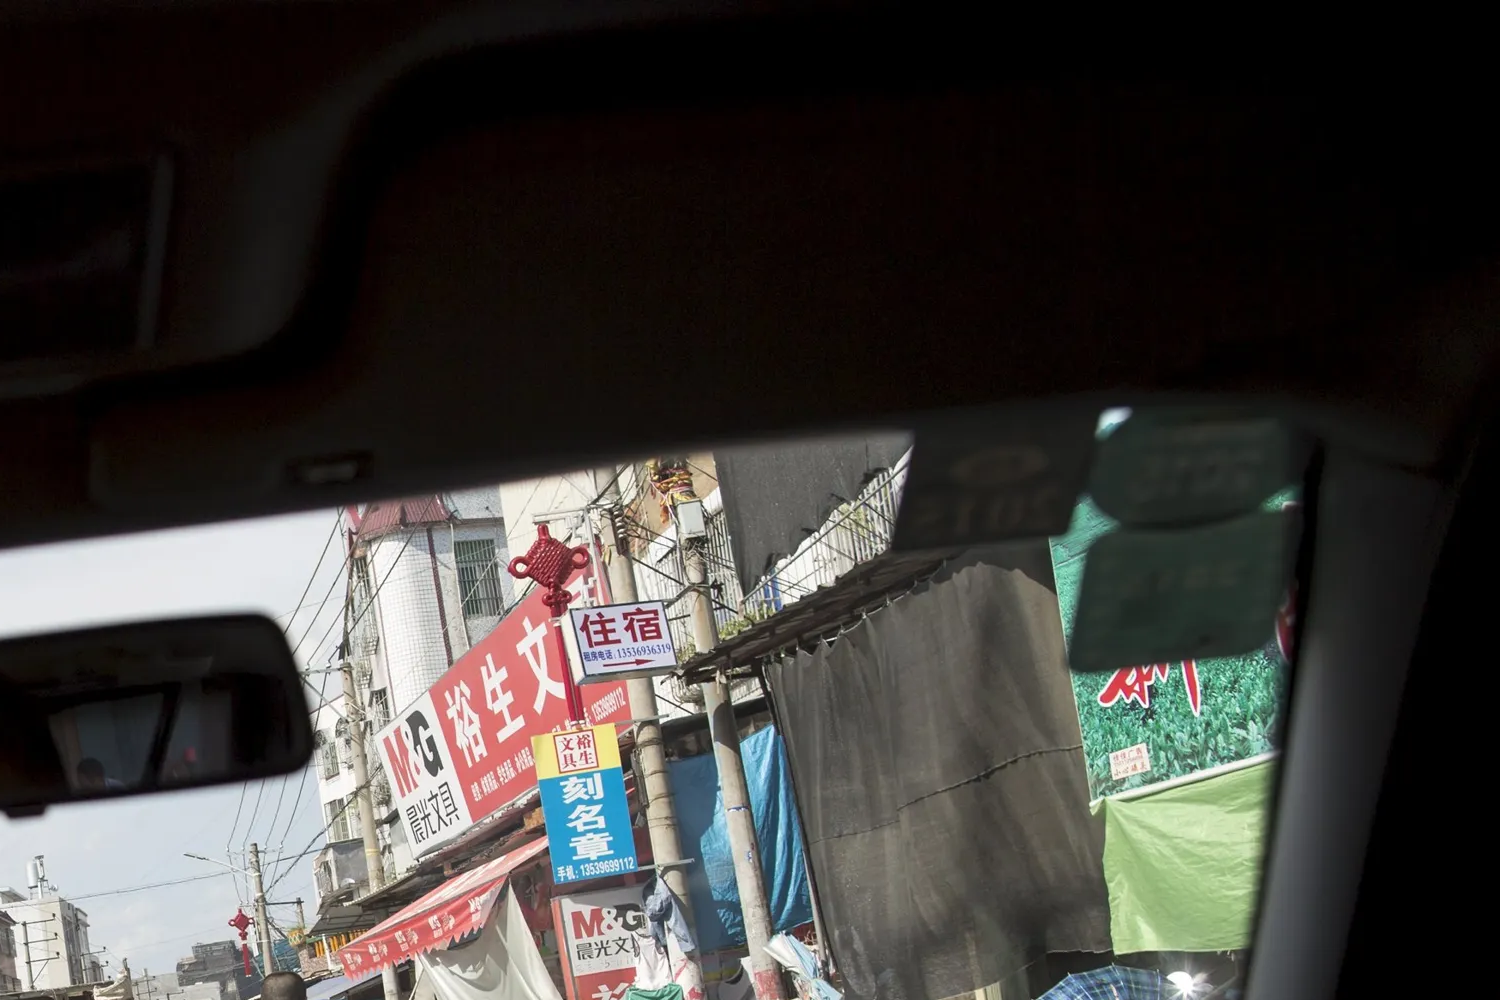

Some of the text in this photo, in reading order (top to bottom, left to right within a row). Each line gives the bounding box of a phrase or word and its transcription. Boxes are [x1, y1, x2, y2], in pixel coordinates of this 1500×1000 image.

[579, 607, 663, 648] 住宿
[383, 710, 443, 799] M&G
[405, 781, 460, 844] 晨光文具
[560, 773, 615, 860] 刻名章
[571, 904, 646, 939] M&G
[575, 935, 637, 961] 晨光文
